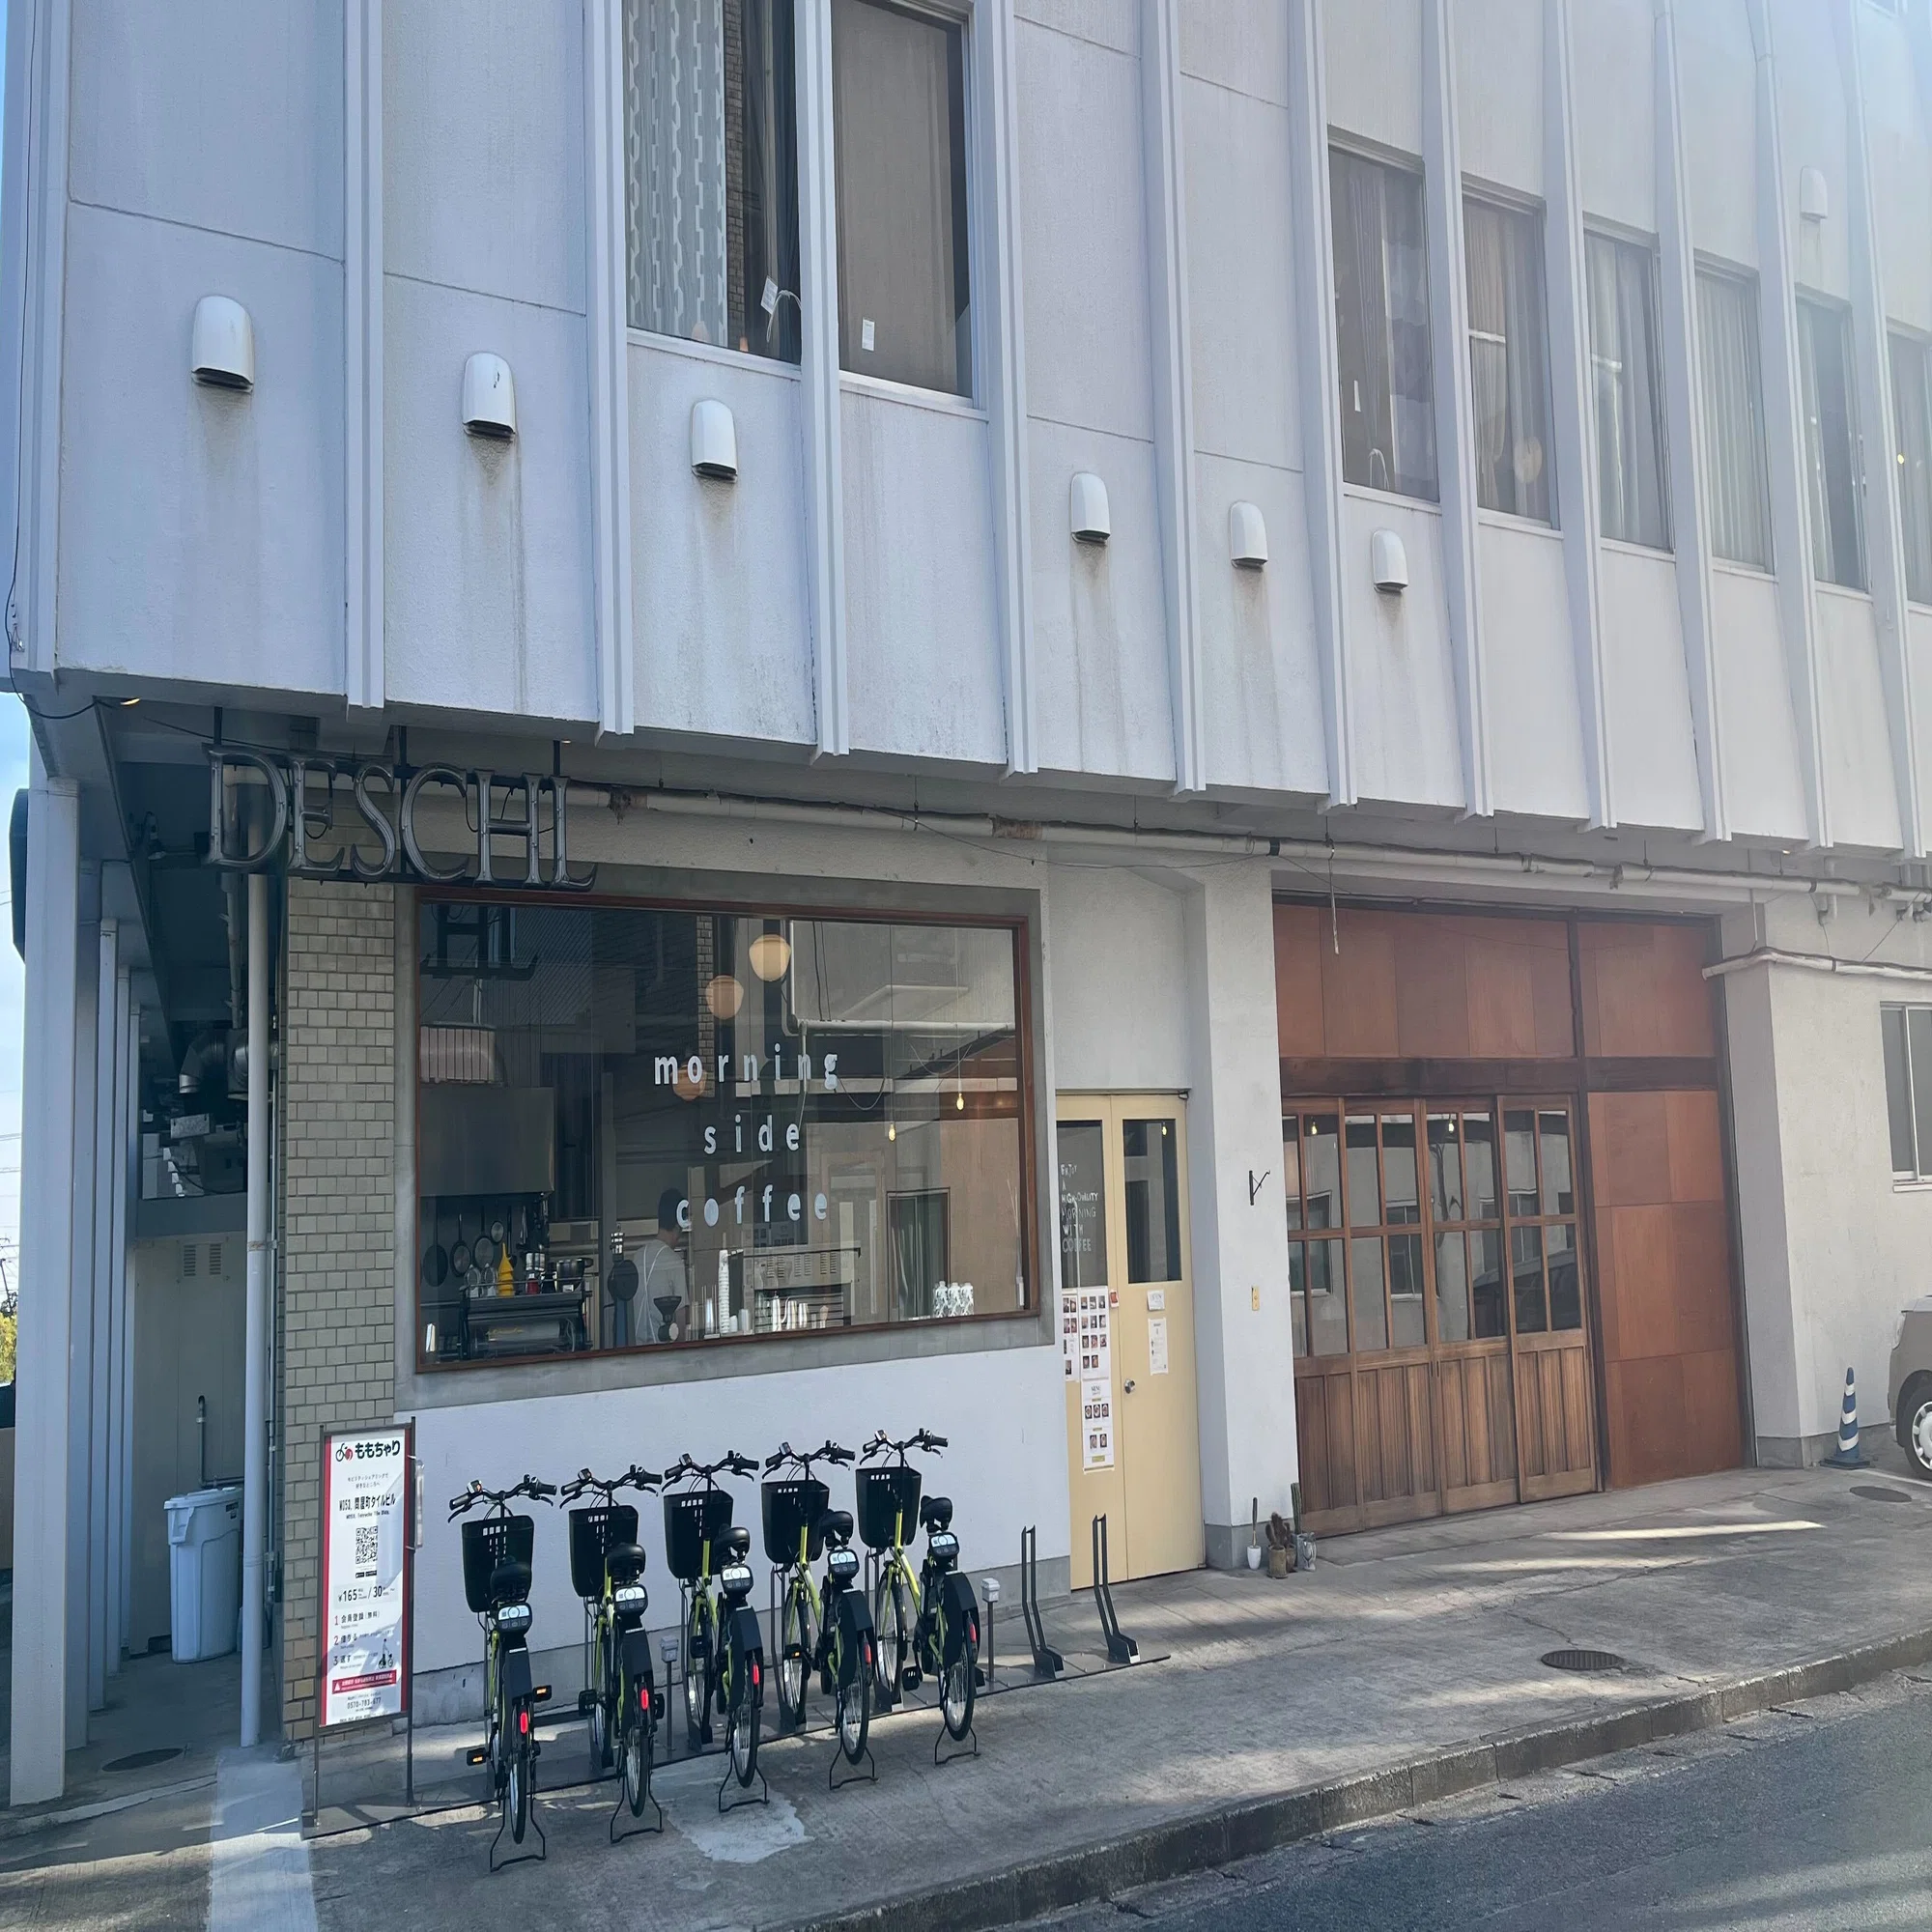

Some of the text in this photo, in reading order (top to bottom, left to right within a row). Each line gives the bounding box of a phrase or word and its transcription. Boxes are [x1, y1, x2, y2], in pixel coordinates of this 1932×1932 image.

[654, 1043, 838, 1091] morning
[703, 1114, 800, 1154] side
[676, 1184, 828, 1228] coffee
[355, 1439, 401, 1460] ももちゃり
